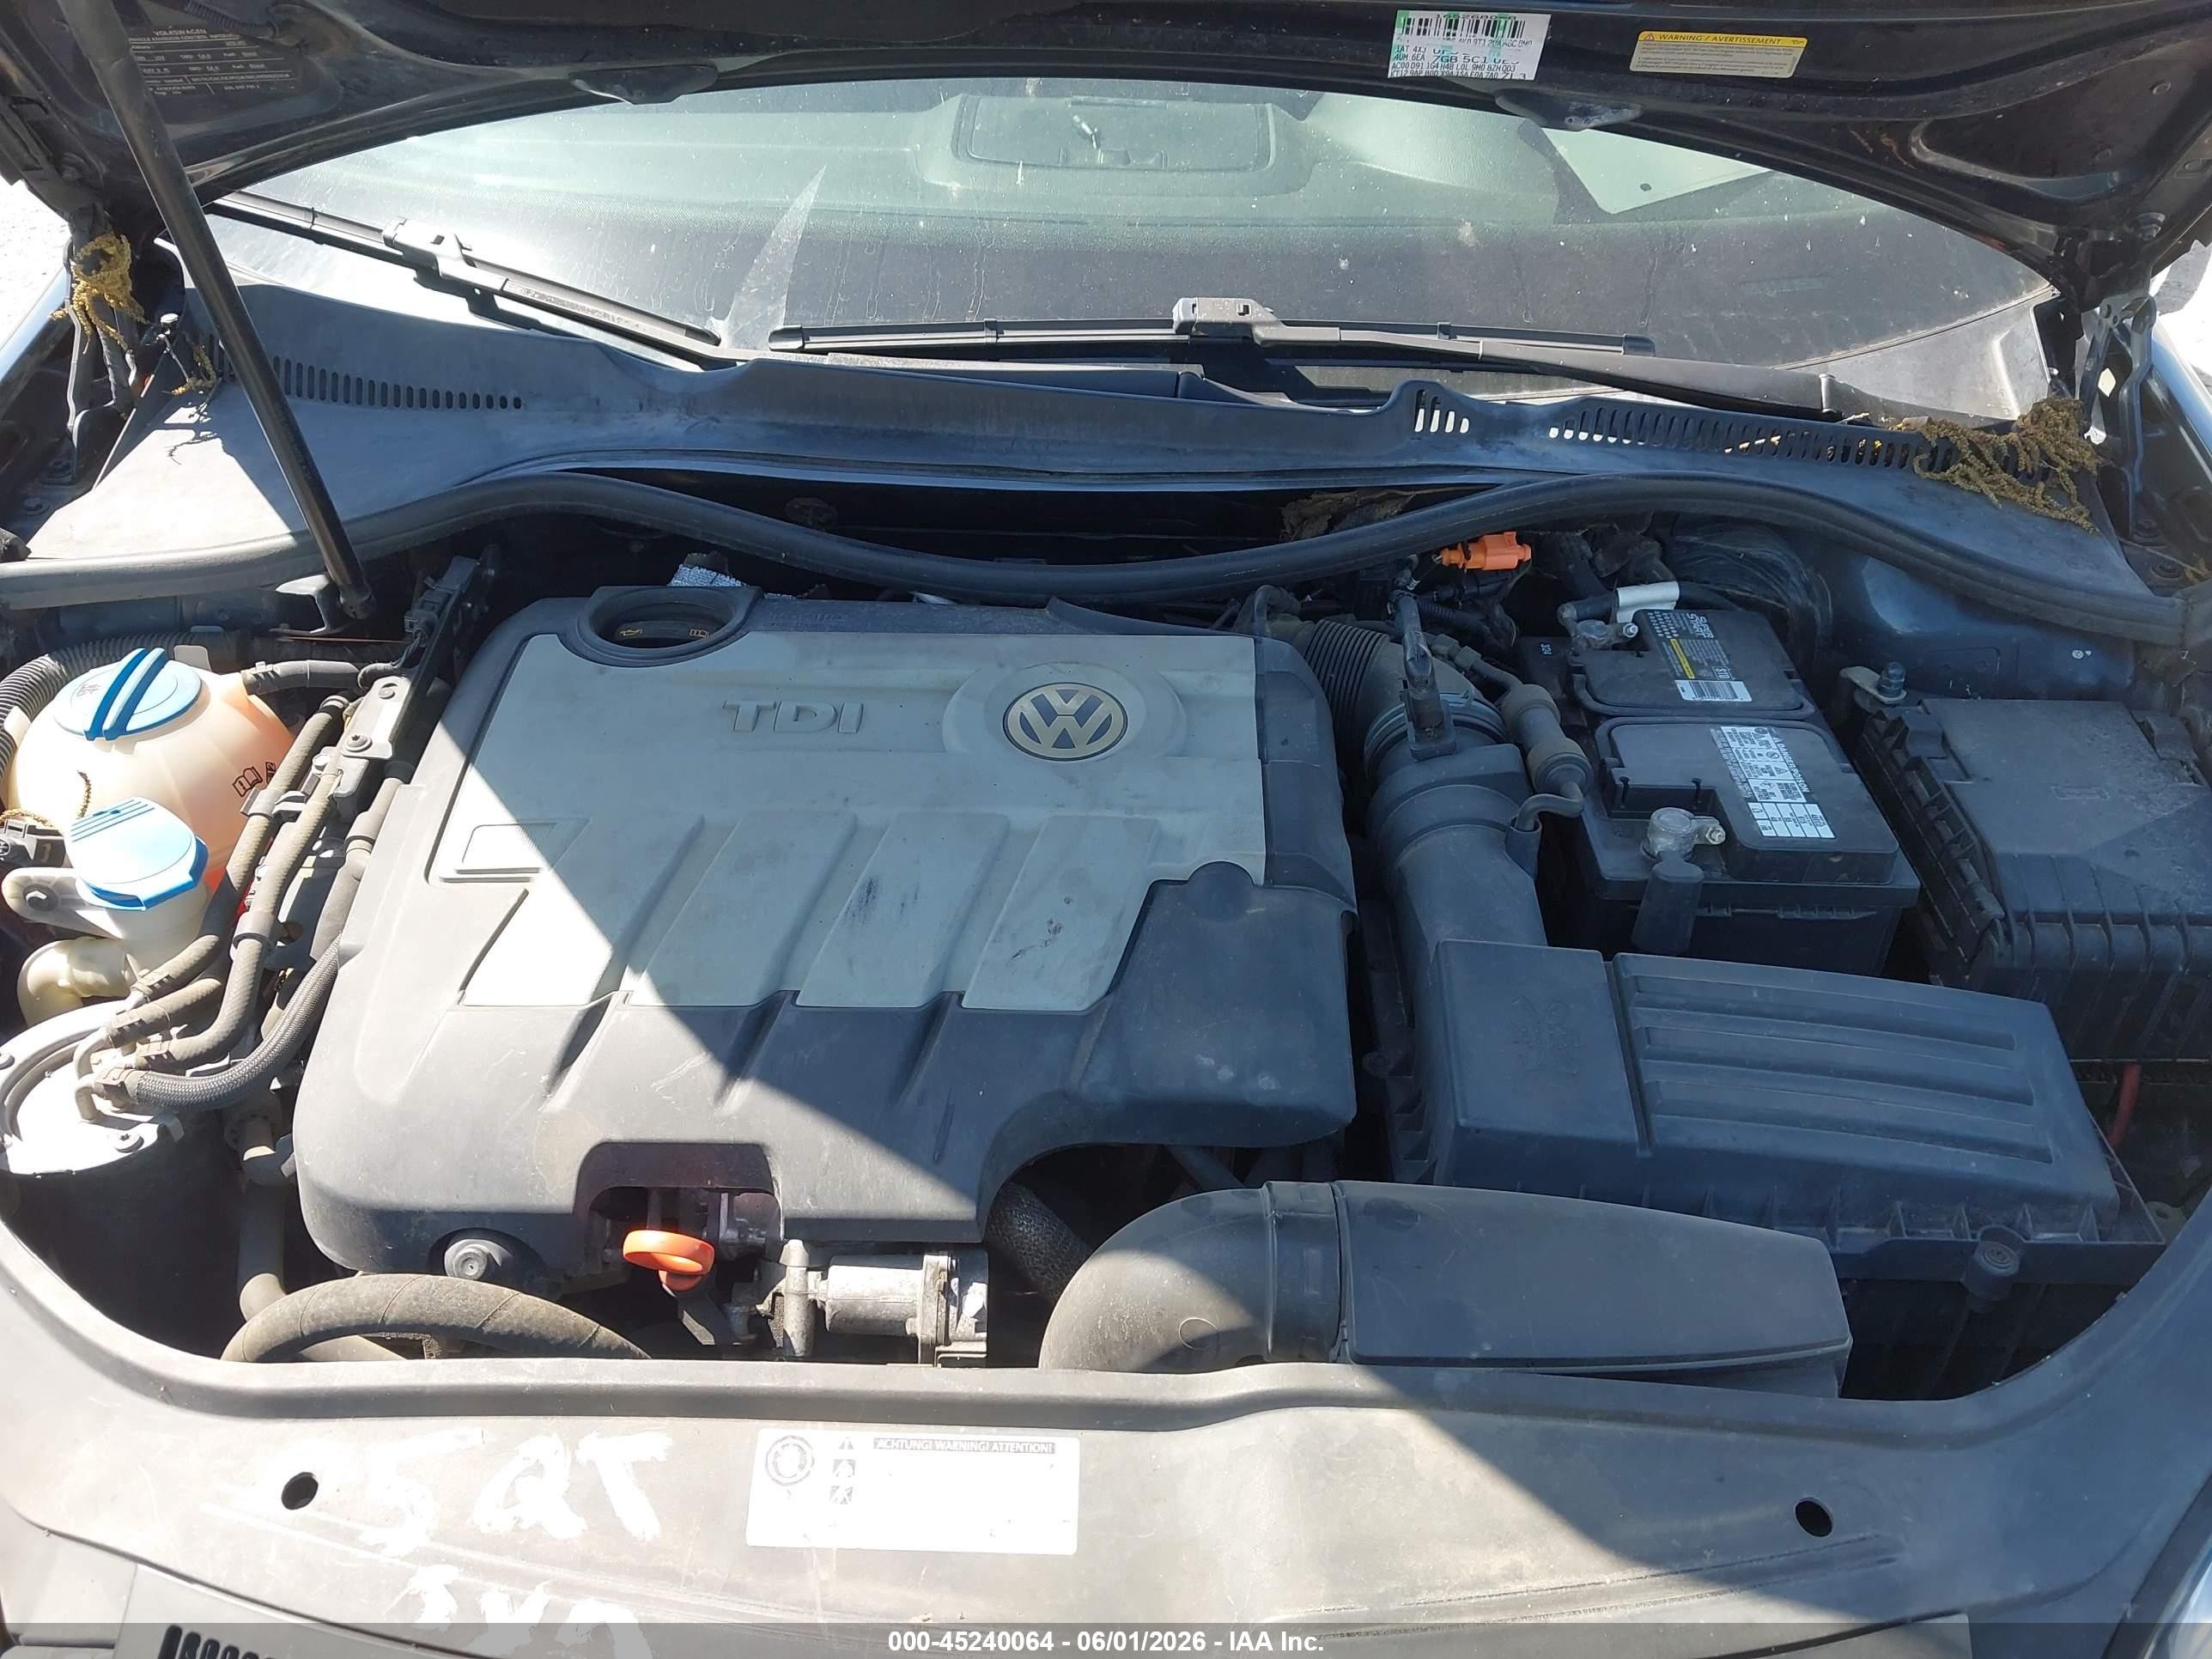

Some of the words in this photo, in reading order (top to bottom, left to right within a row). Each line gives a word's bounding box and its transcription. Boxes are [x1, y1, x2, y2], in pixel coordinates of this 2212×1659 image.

[1711, 35, 1782, 45] AVERTISSEMENT
[722, 700, 864, 734] TDI
[877, 1438, 933, 1449] ACHTUNG!
[933, 1439, 989, 1451] WARNING!
[991, 1441, 1054, 1454] ATTENTION!
